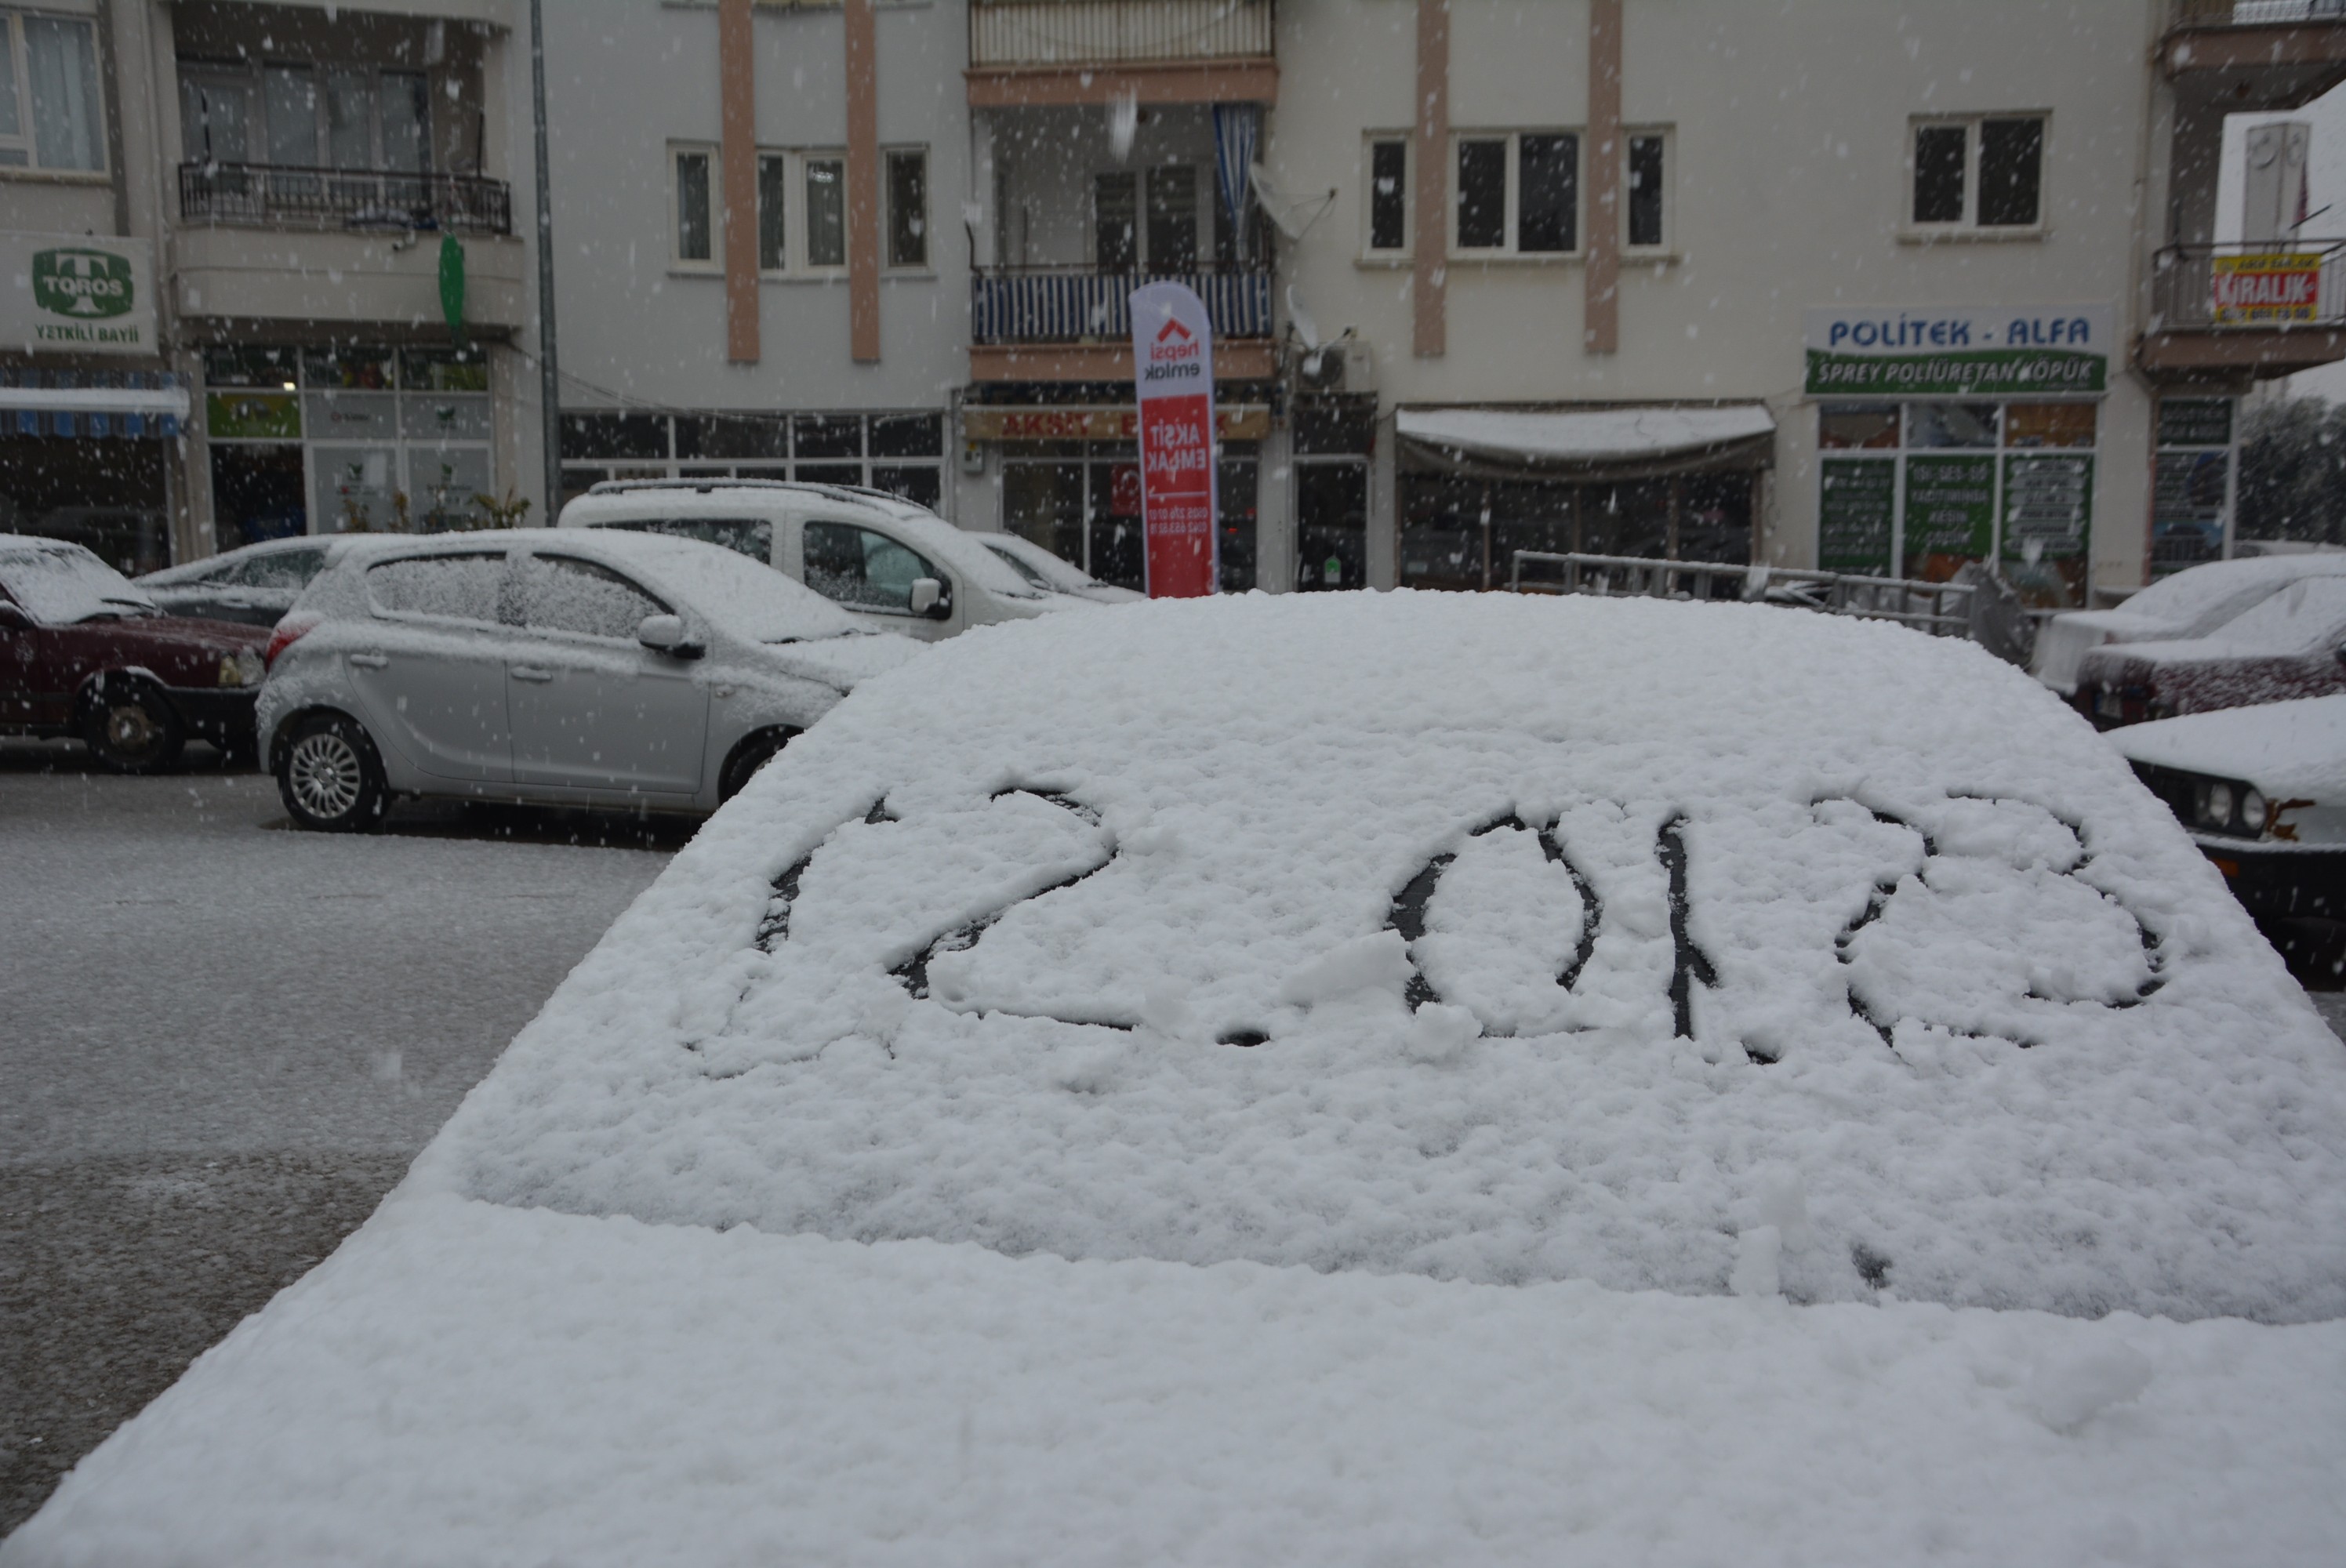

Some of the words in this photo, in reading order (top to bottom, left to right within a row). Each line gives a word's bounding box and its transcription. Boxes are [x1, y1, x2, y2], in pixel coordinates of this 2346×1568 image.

[42, 275, 125, 297] TOROS
[35, 322, 93, 342] YETKİLİ
[98, 325, 140, 344] BAYİİ
[1829, 313, 1972, 347] POLİTEK
[2006, 318, 2090, 344] ALFA
[1817, 361, 1879, 384] SPREY
[1884, 358, 2016, 383] POLİÜRETAN
